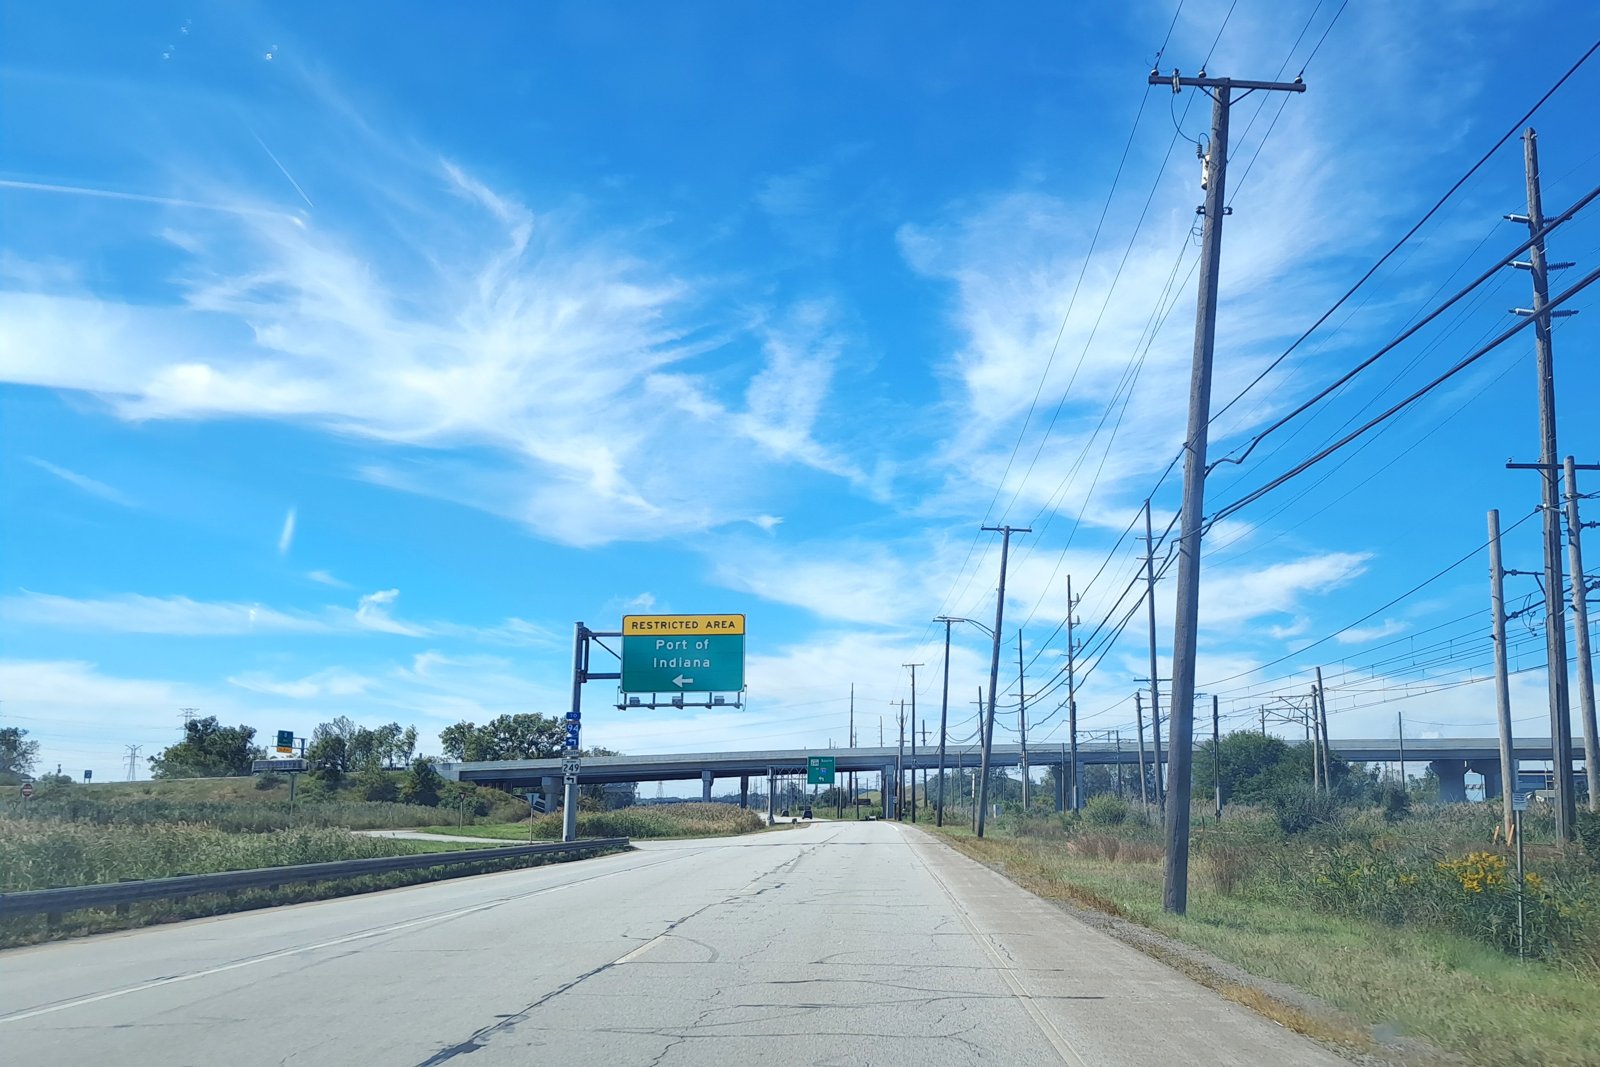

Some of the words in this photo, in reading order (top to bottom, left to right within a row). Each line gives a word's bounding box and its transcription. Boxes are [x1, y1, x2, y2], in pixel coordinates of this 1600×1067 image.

[631, 620, 699, 630] RESTRICTED
[705, 620, 736, 629] AREA
[655, 639, 688, 650] Port
[695, 638, 710, 650] of
[653, 657, 710, 668] Indiana
[567, 724, 579, 732] 94
[563, 763, 580, 772] 249
